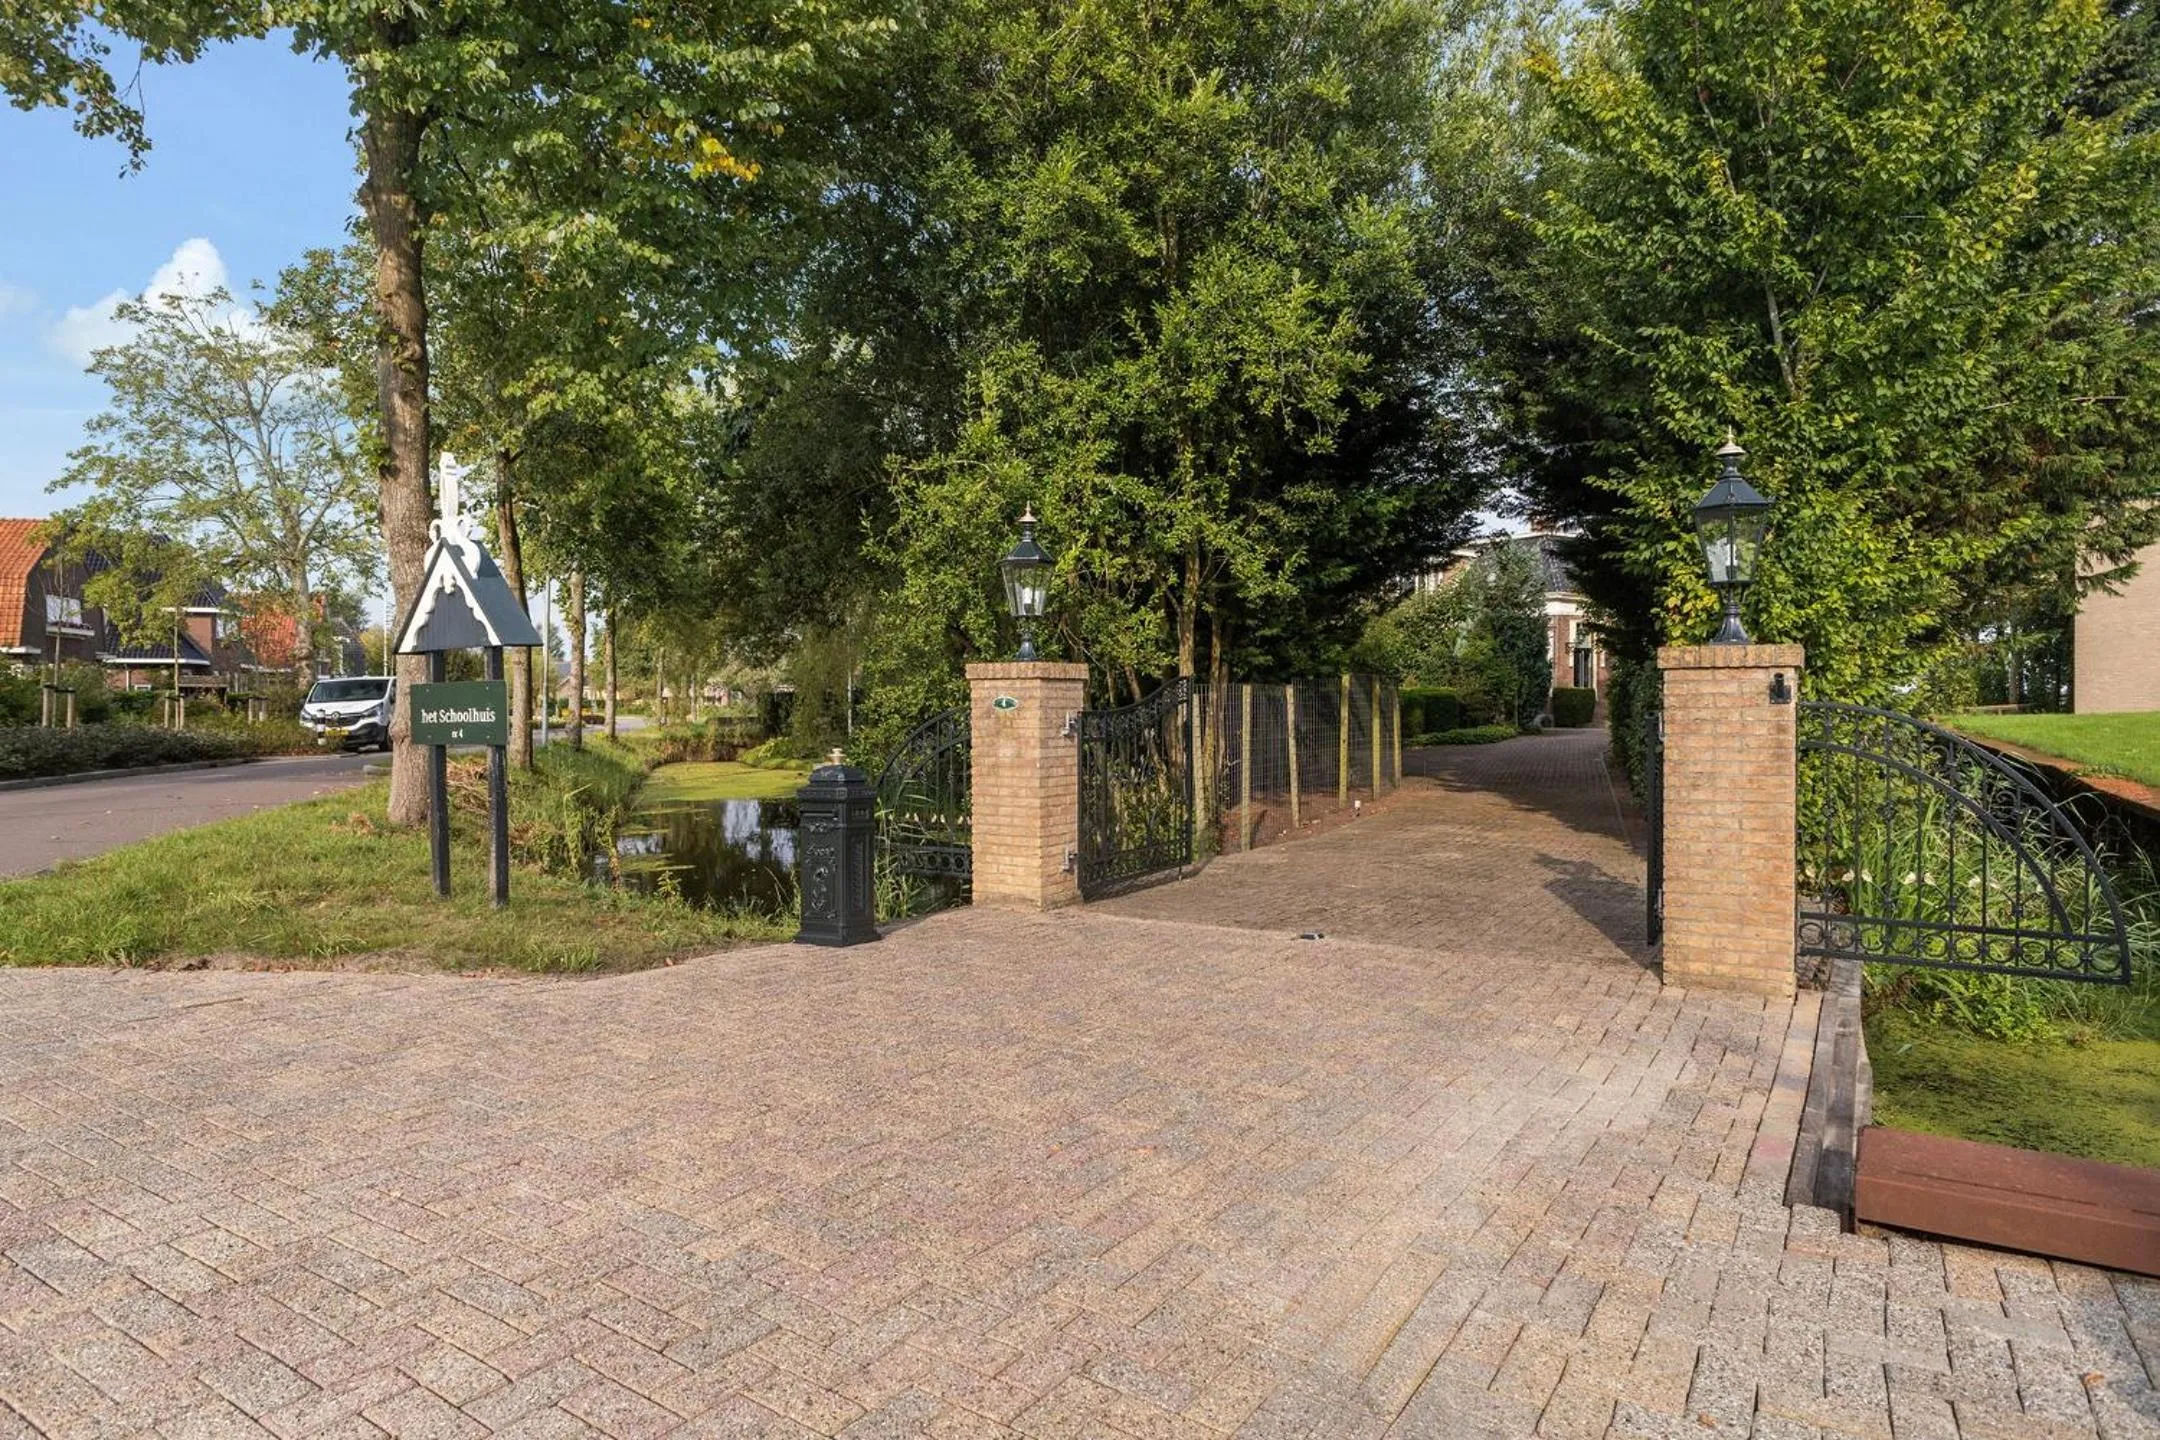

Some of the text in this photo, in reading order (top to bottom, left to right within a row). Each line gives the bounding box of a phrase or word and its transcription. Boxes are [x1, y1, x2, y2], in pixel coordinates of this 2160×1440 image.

[421, 707, 496, 724] het Schoolhuis
[459, 728, 464, 738] 4
